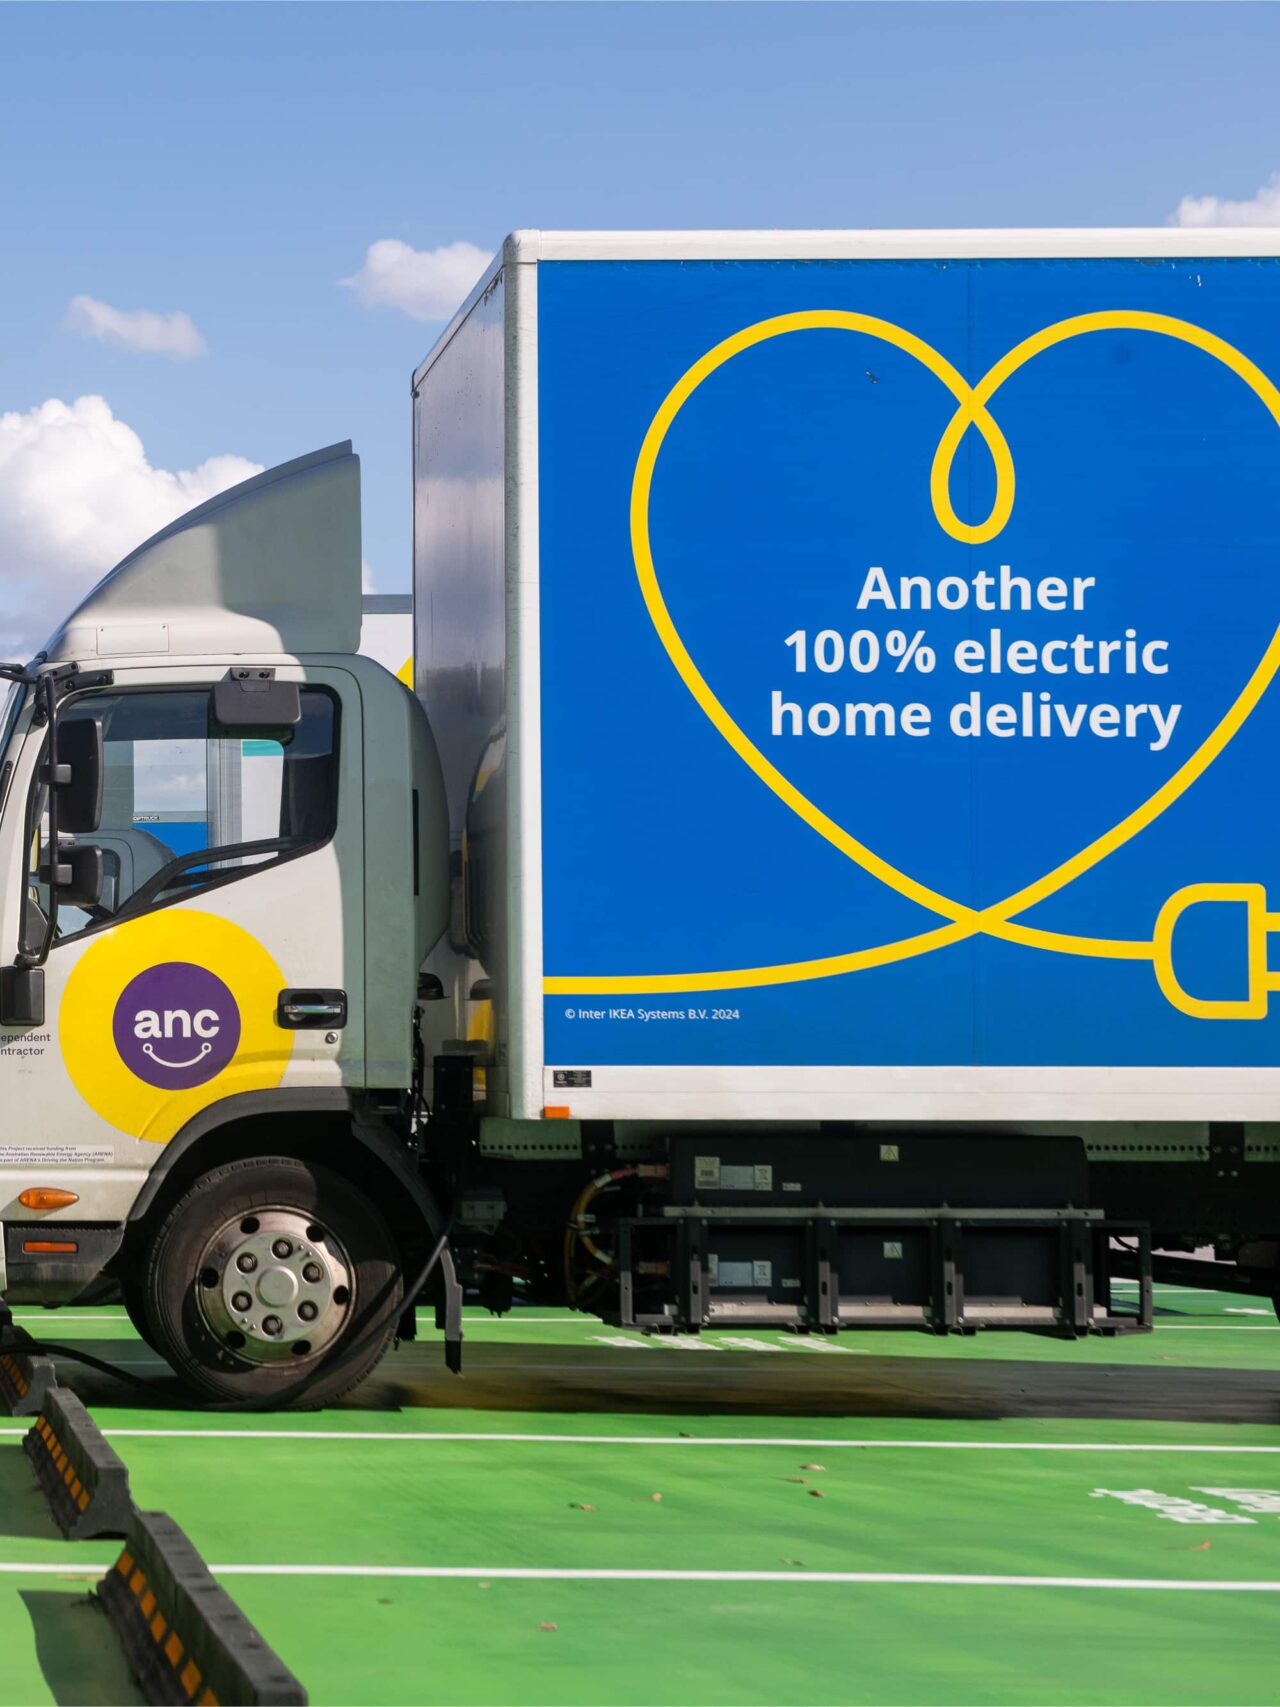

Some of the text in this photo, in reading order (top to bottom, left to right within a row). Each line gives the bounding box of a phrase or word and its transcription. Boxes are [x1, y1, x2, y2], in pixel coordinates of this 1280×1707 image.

[856, 565, 1096, 611] Another
[783, 628, 1169, 675] 100% electric
[771, 690, 1182, 751] home delivery
[134, 1008, 220, 1039] anc
[578, 1009, 606, 1019] Inter
[609, 1009, 635, 1019] IKEA
[637, 1008, 686, 1021] Systems
[688, 1009, 708, 1019] B.V.
[711, 1009, 740, 1019] 2024
